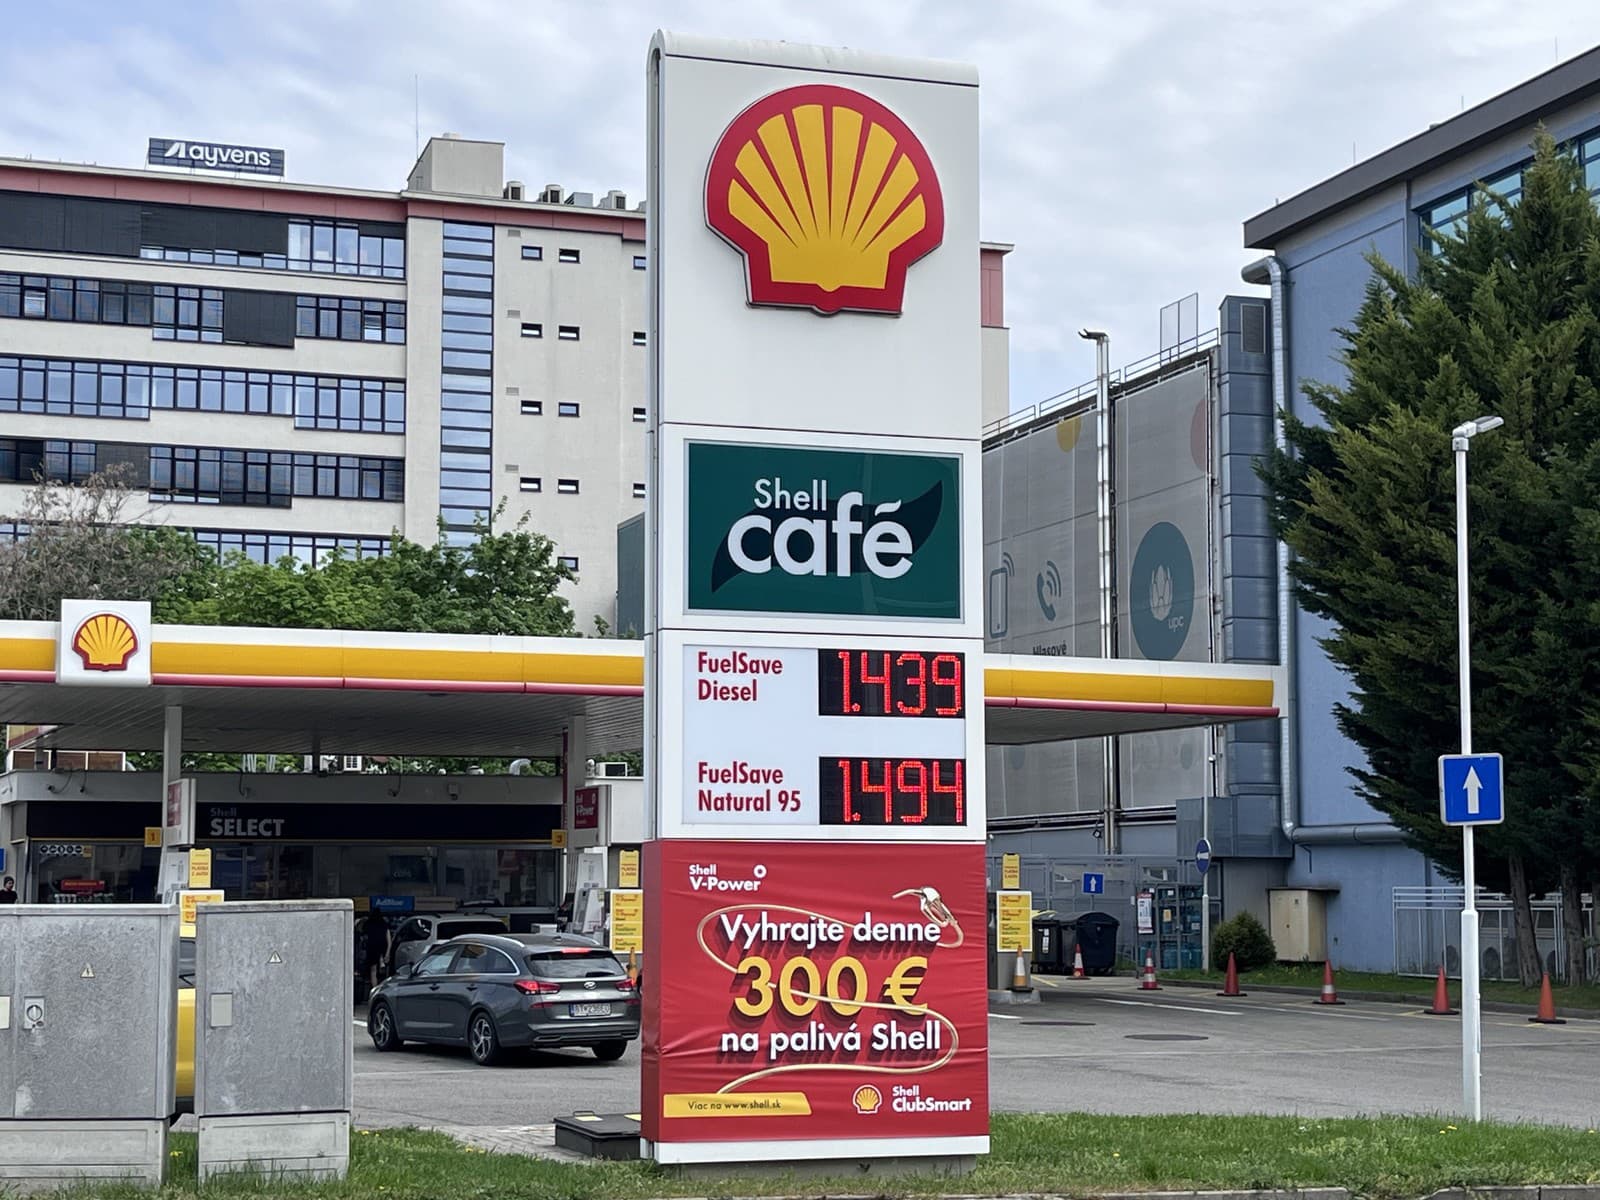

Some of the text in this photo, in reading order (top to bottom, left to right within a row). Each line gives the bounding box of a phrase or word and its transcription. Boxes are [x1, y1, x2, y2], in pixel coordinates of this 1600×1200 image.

[189, 145, 271, 167] ayvens
[754, 477, 827, 511] Shell
[727, 491, 913, 579] café
[1168, 616, 1184, 632] upc
[698, 652, 783, 676] FuelSave
[698, 679, 758, 702] Diesel
[838, 651, 963, 716] 1.439
[698, 761, 783, 785] FuelSave
[698, 789, 801, 813] Natural 95
[838, 760, 963, 825] 1.494
[210, 807, 237, 817] Shell
[209, 818, 285, 837] SELECT
[689, 864, 717, 875] Shell
[689, 876, 761, 891] V-Power
[720, 911, 941, 949] Vyhrajte denne
[734, 956, 928, 1017] 300 €
[721, 1020, 940, 1059] na palivá Shell
[892, 1085, 919, 1097] Shell
[688, 1102, 708, 1110] Viac
[725, 1100, 781, 1109] www.shell.sk
[892, 1097, 972, 1112] ClubSmart
